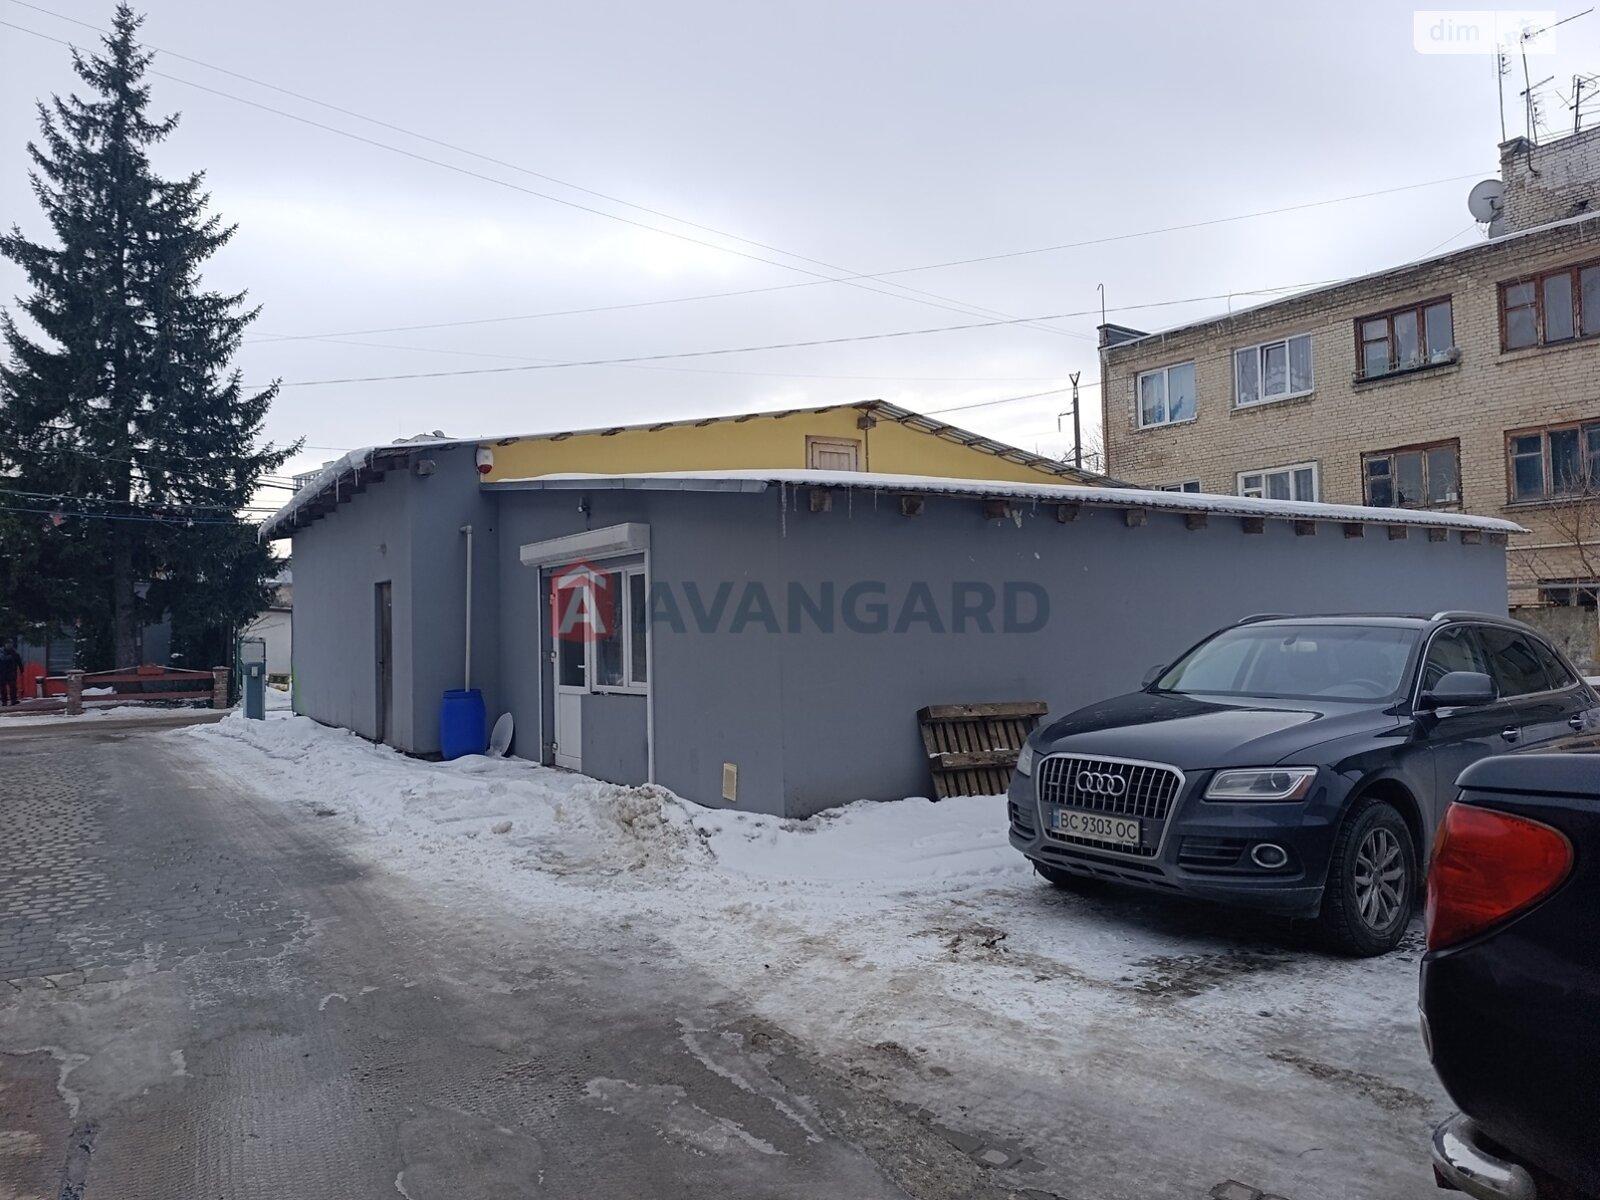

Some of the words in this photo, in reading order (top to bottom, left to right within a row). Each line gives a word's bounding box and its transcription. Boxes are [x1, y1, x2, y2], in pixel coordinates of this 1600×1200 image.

[1060, 812, 1078, 830] BC
[1081, 816, 1112, 836] 9303
[1115, 822, 1137, 840] OC
